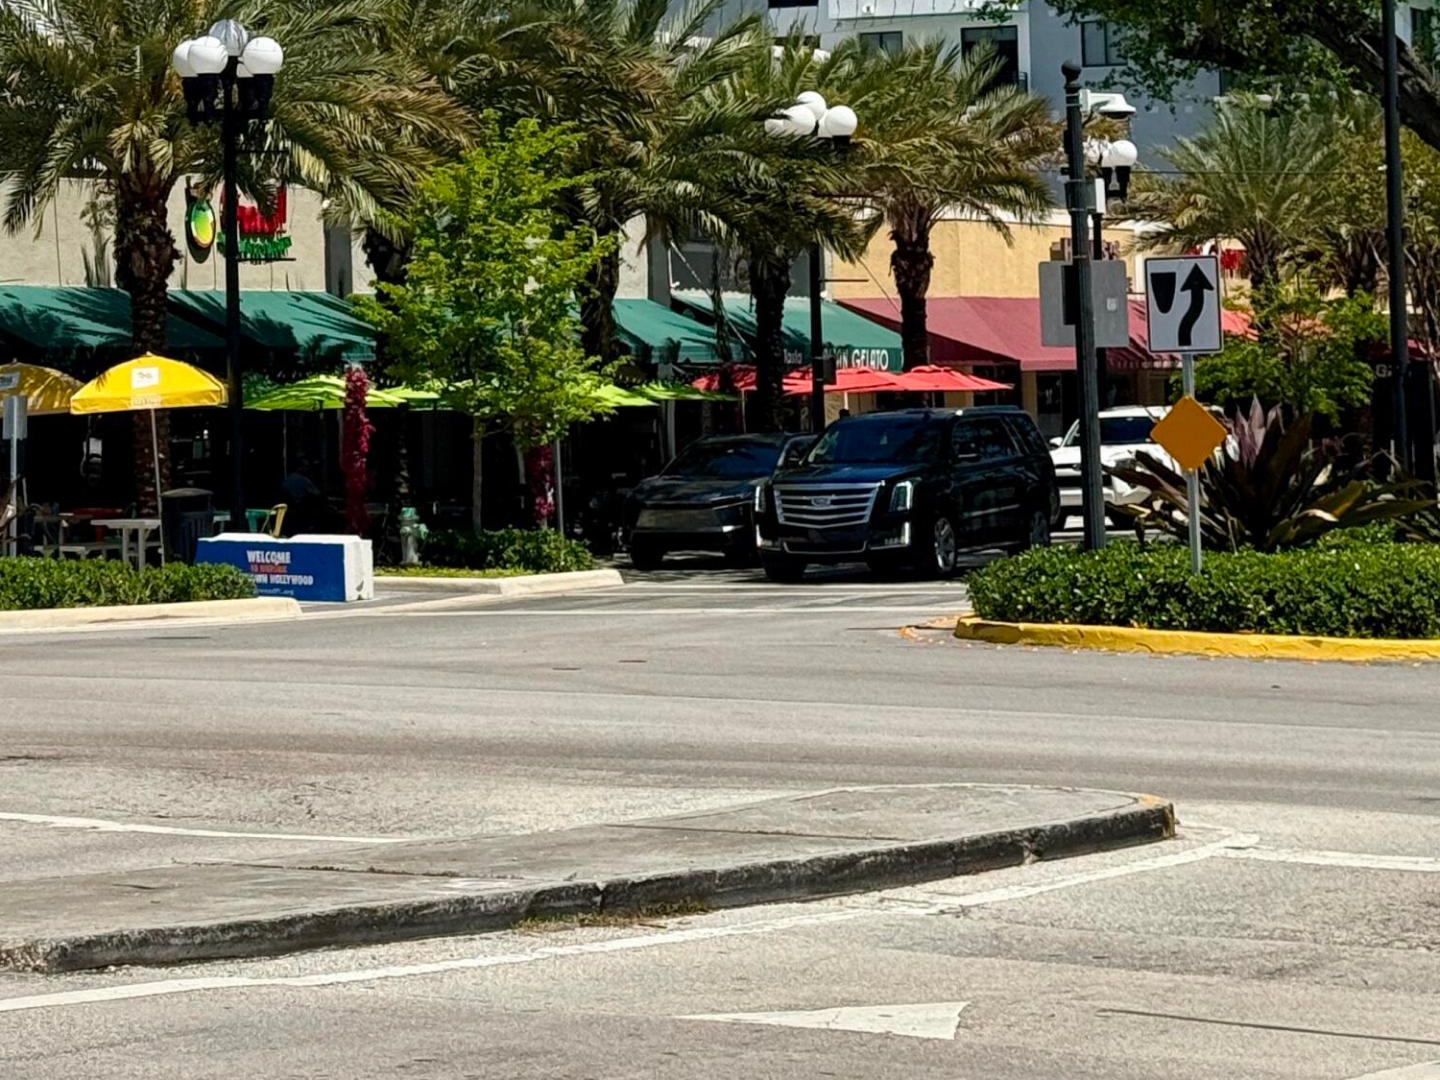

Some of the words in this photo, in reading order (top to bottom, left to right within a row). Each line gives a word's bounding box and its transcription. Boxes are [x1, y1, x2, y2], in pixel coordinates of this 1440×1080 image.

[851, 348, 889, 371] GELATO
[246, 550, 291, 564] WELCOME
[269, 574, 314, 586] HOLLYWOOD
